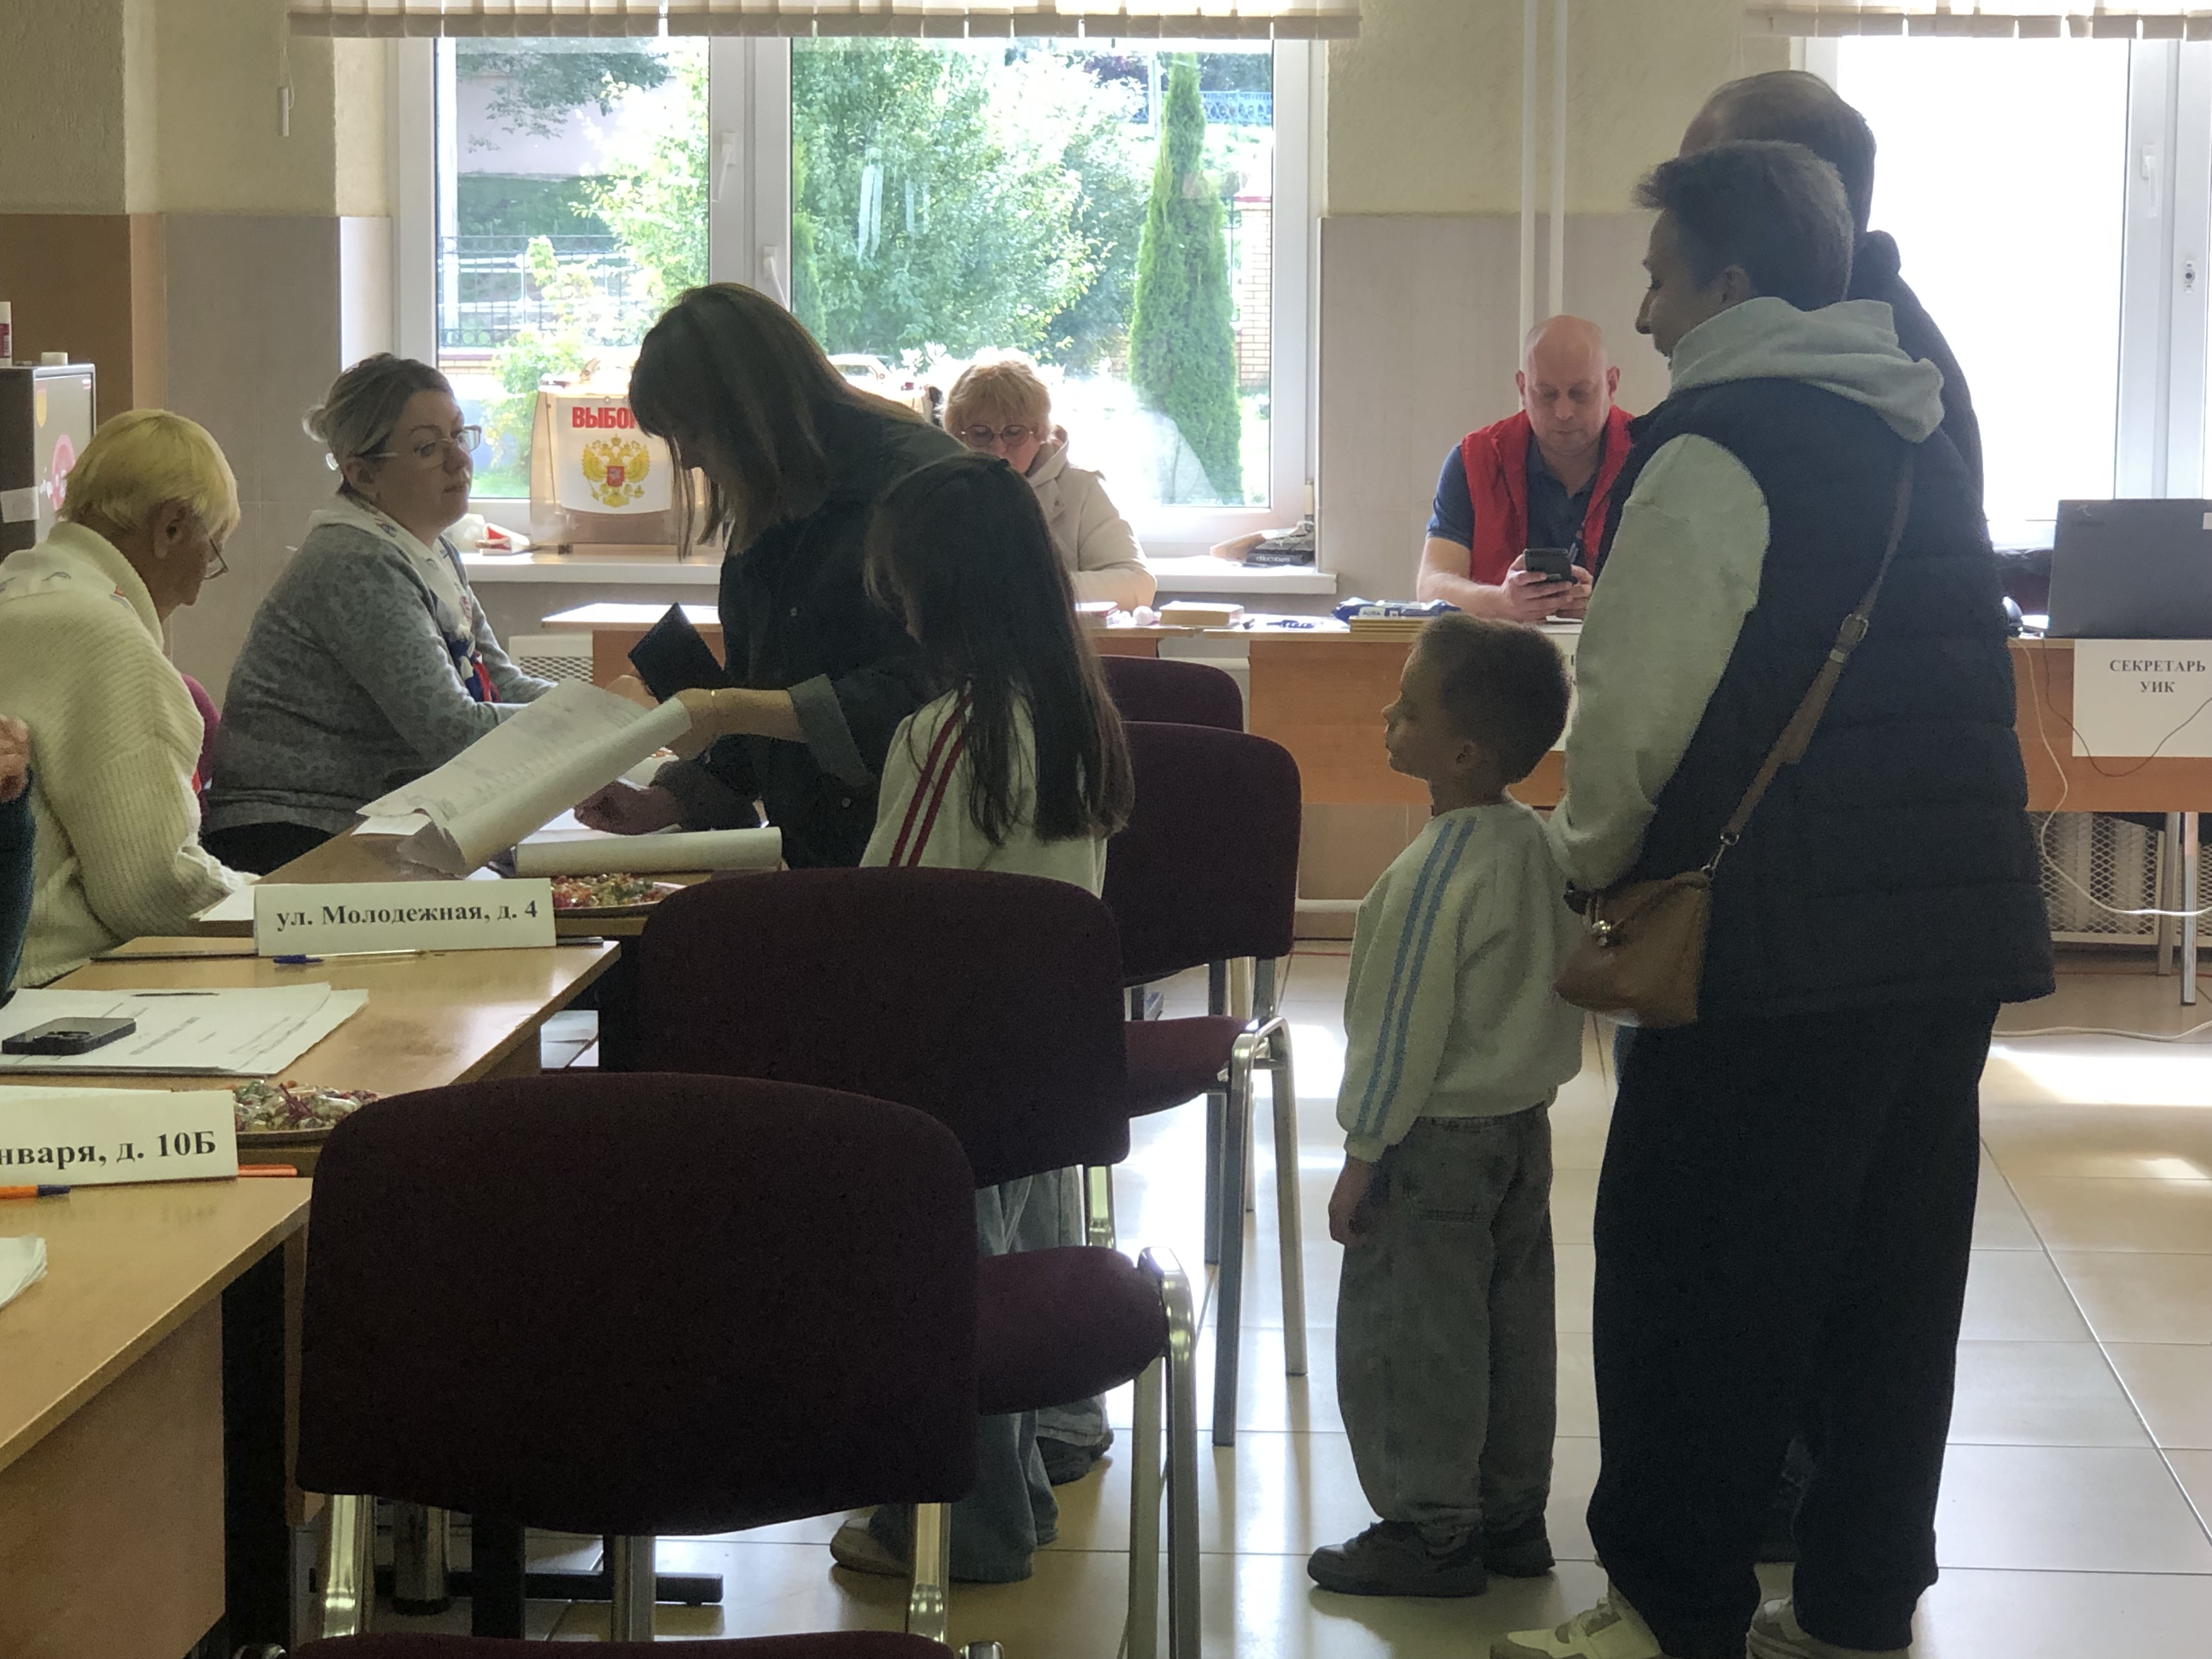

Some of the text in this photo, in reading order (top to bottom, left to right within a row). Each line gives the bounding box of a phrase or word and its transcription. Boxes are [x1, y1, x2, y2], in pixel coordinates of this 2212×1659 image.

[2109, 659, 2206, 672] СЕКРЕТАРЬ
[2140, 681, 2175, 693] УИК
[276, 900, 538, 932] ул. Молодежная, д. 4
[116, 1142, 144, 1164] д.
[157, 1130, 216, 1157] 10Б
